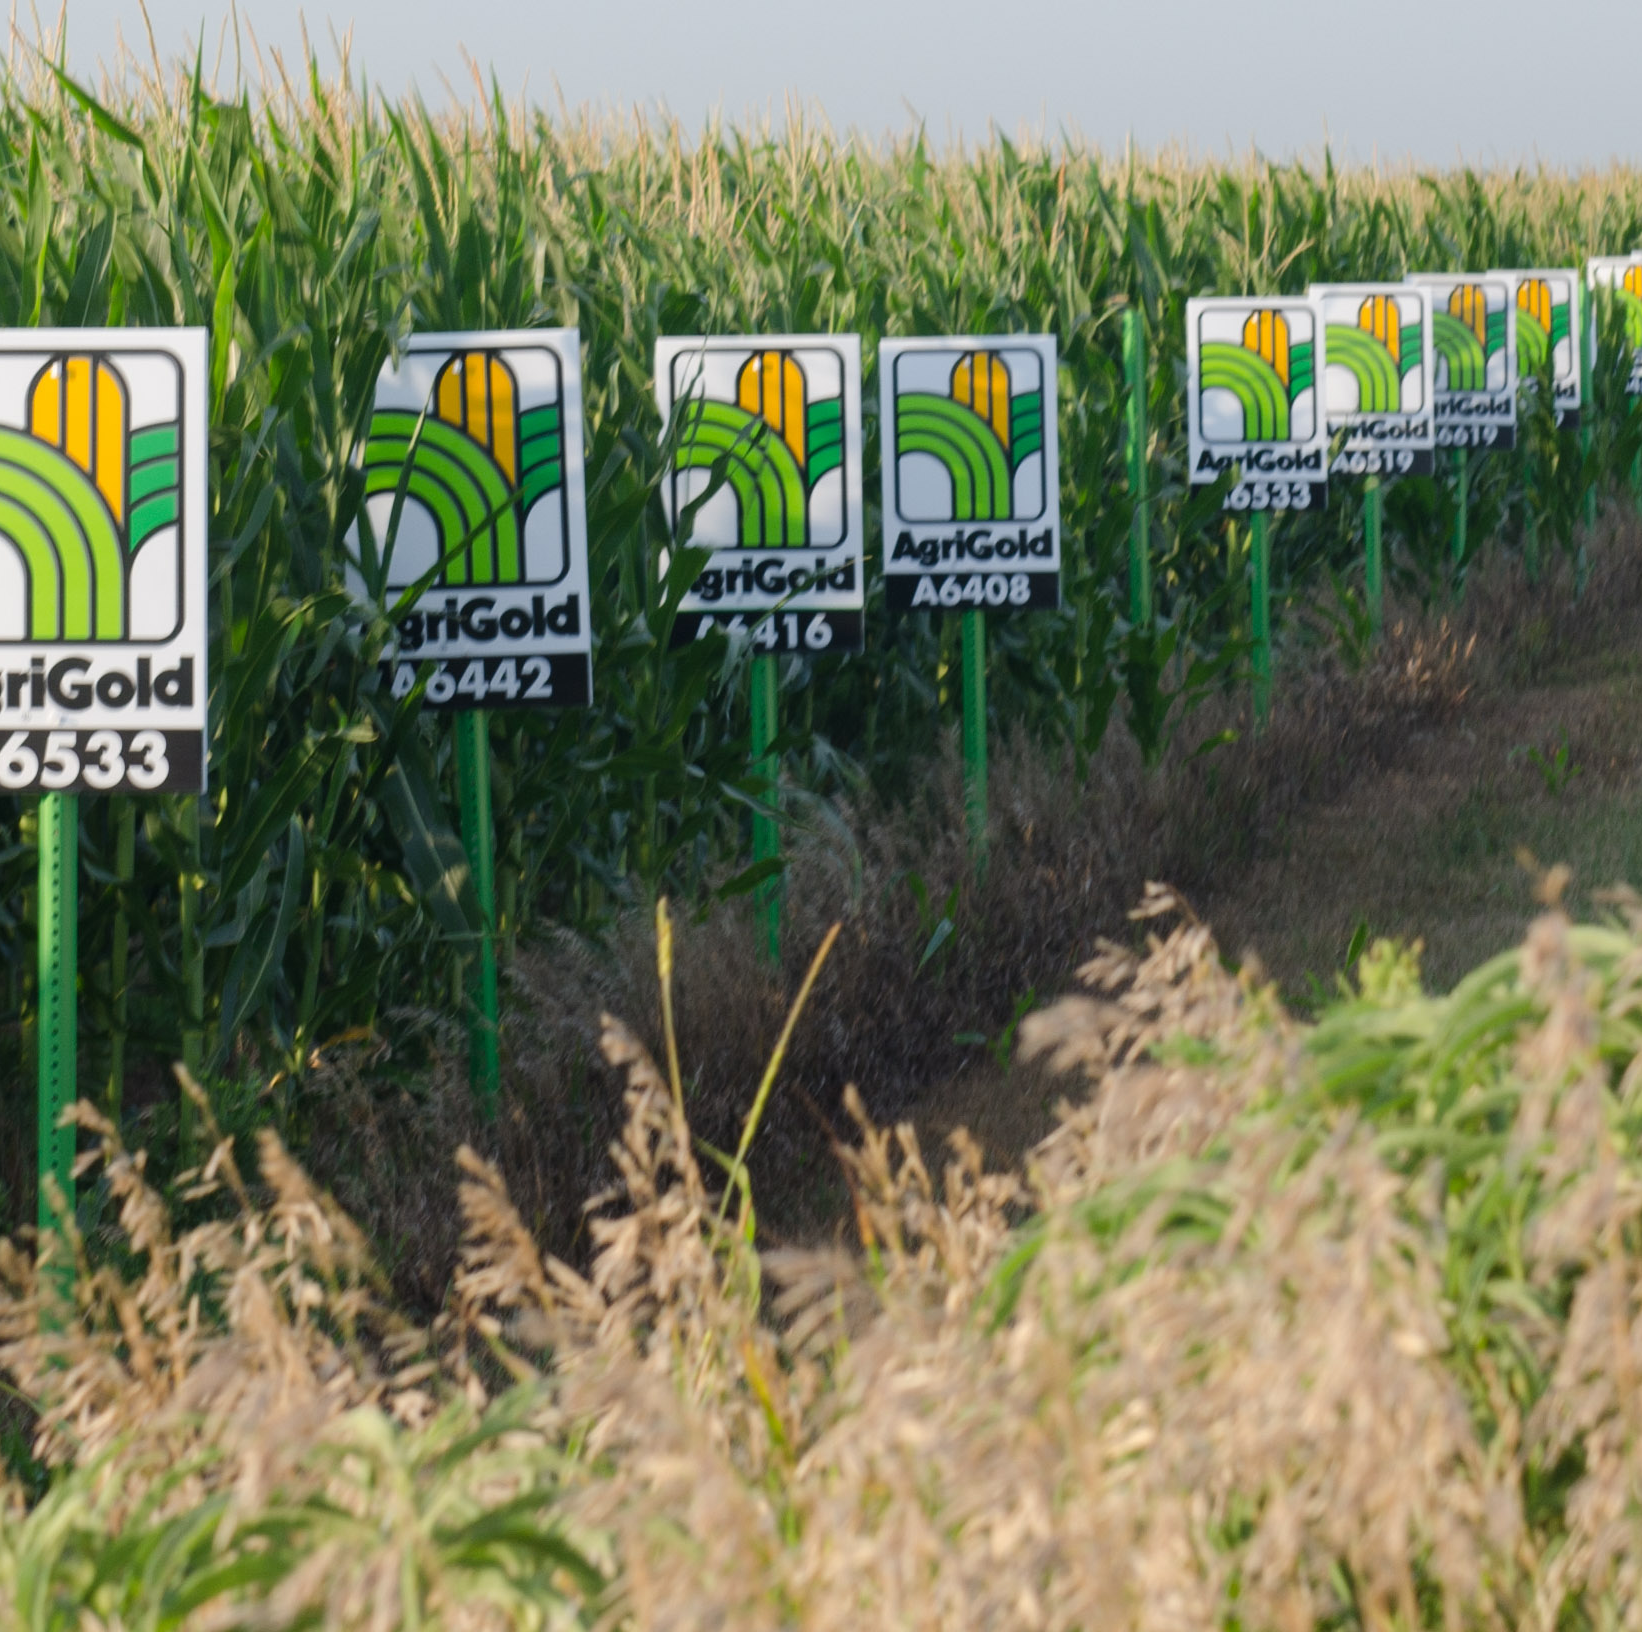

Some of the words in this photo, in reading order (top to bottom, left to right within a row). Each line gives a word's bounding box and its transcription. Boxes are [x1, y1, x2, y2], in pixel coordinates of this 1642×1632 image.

[1437, 426, 1499, 447] 6619
[1222, 481, 1312, 511] 6533
[891, 528, 1054, 567] AgriGold
[688, 557, 855, 602] griGold
[911, 573, 1032, 608] A6408
[361, 594, 581, 651] griGold
